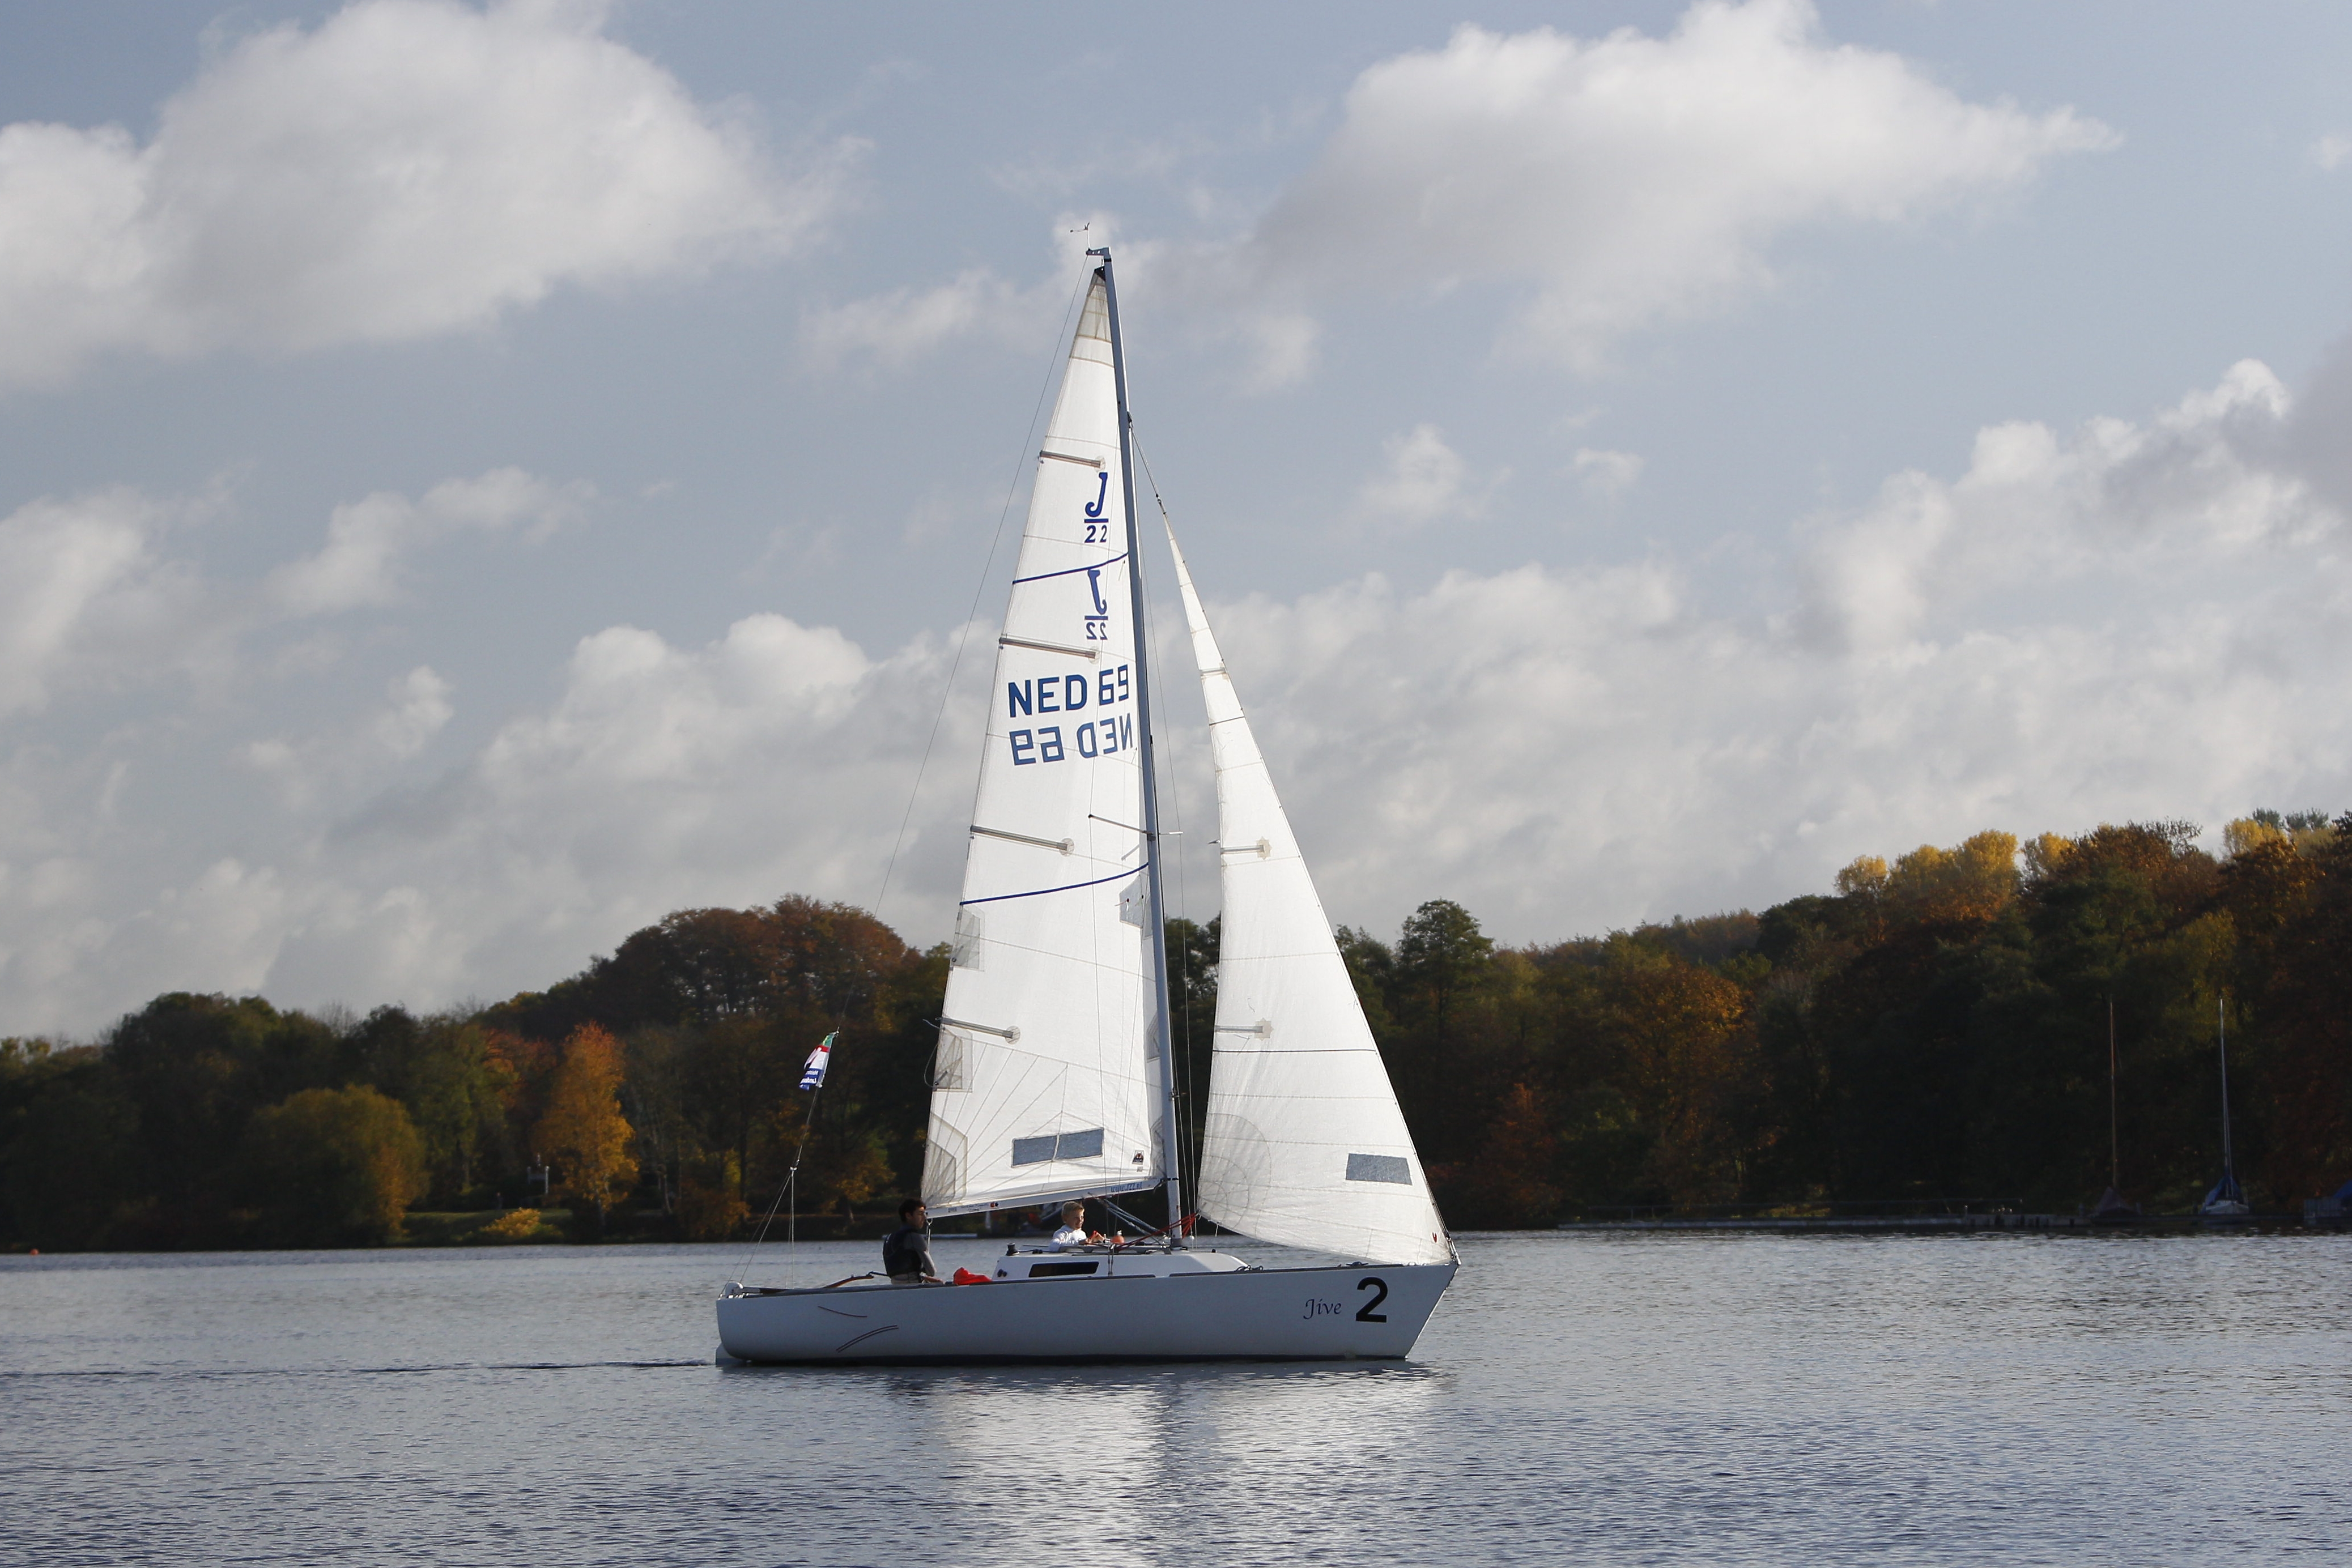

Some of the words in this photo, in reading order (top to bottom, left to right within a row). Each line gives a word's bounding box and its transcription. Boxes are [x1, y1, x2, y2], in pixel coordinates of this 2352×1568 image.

[1085, 471, 1108, 517] J
[1084, 525, 1107, 543] 22
[1008, 674, 1087, 717] NED
[1099, 664, 1129, 705] 69
[1303, 1298, 1342, 1320] Jive
[1355, 1277, 1388, 1323] 2
